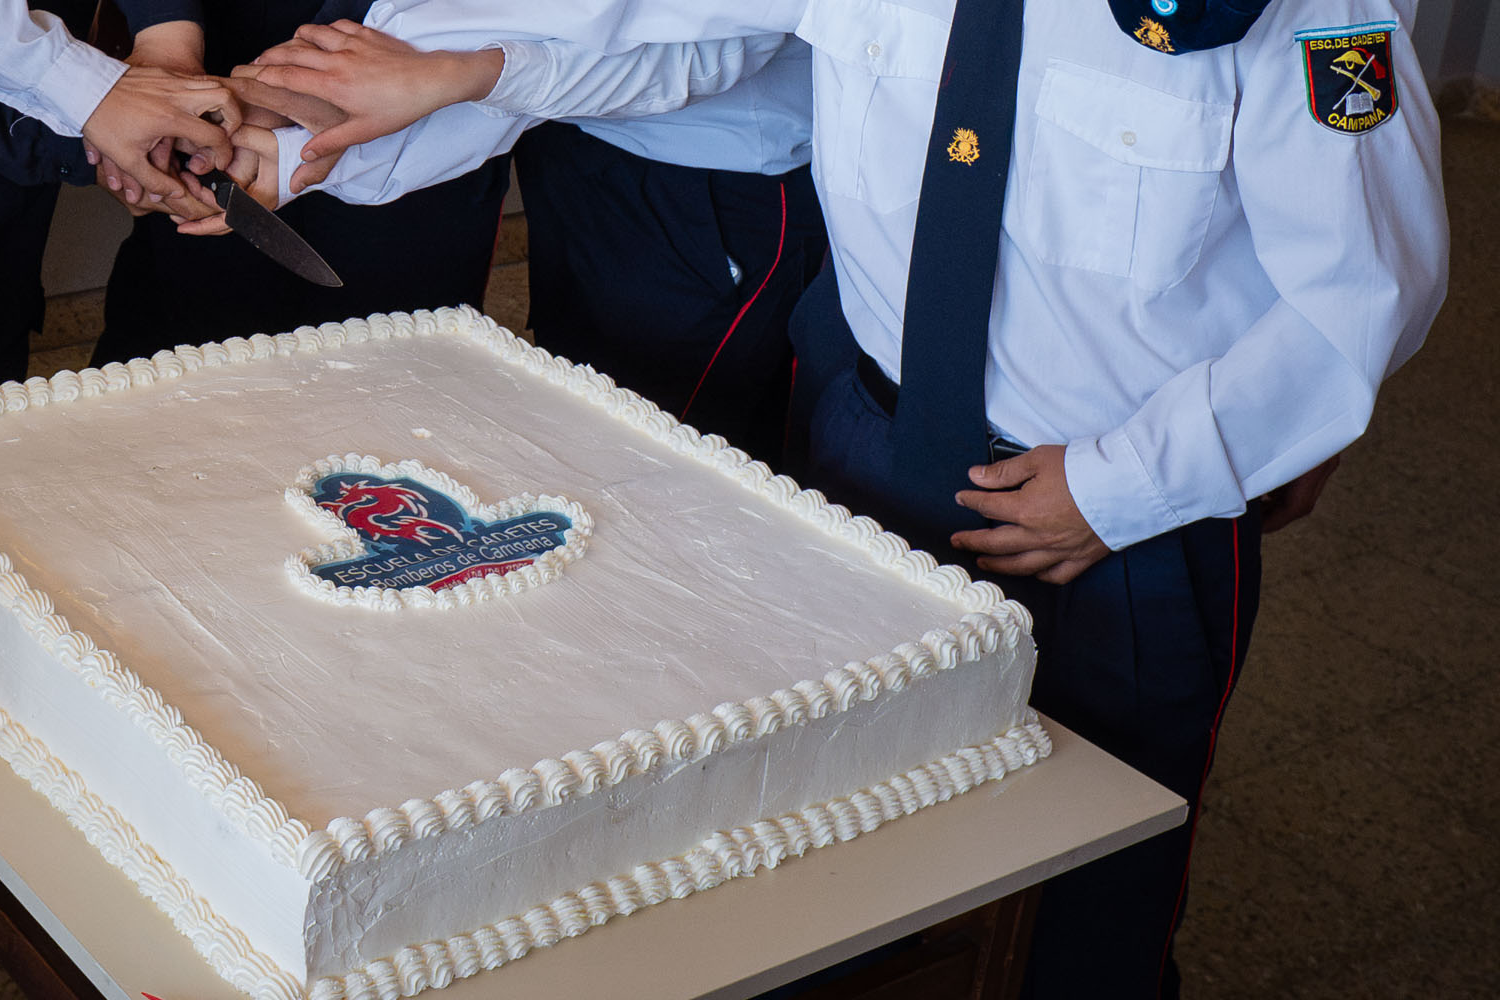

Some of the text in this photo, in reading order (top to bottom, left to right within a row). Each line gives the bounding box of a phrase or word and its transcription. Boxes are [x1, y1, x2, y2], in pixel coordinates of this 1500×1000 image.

[1351, 32, 1386, 47] CADETES
[1328, 107, 1386, 131] CAMPANA
[334, 552, 433, 584] ESCUELA
[467, 518, 559, 547] CADETES
[369, 560, 457, 590] Bomberos
[456, 552, 481, 566] de
[479, 535, 555, 560] Campana
